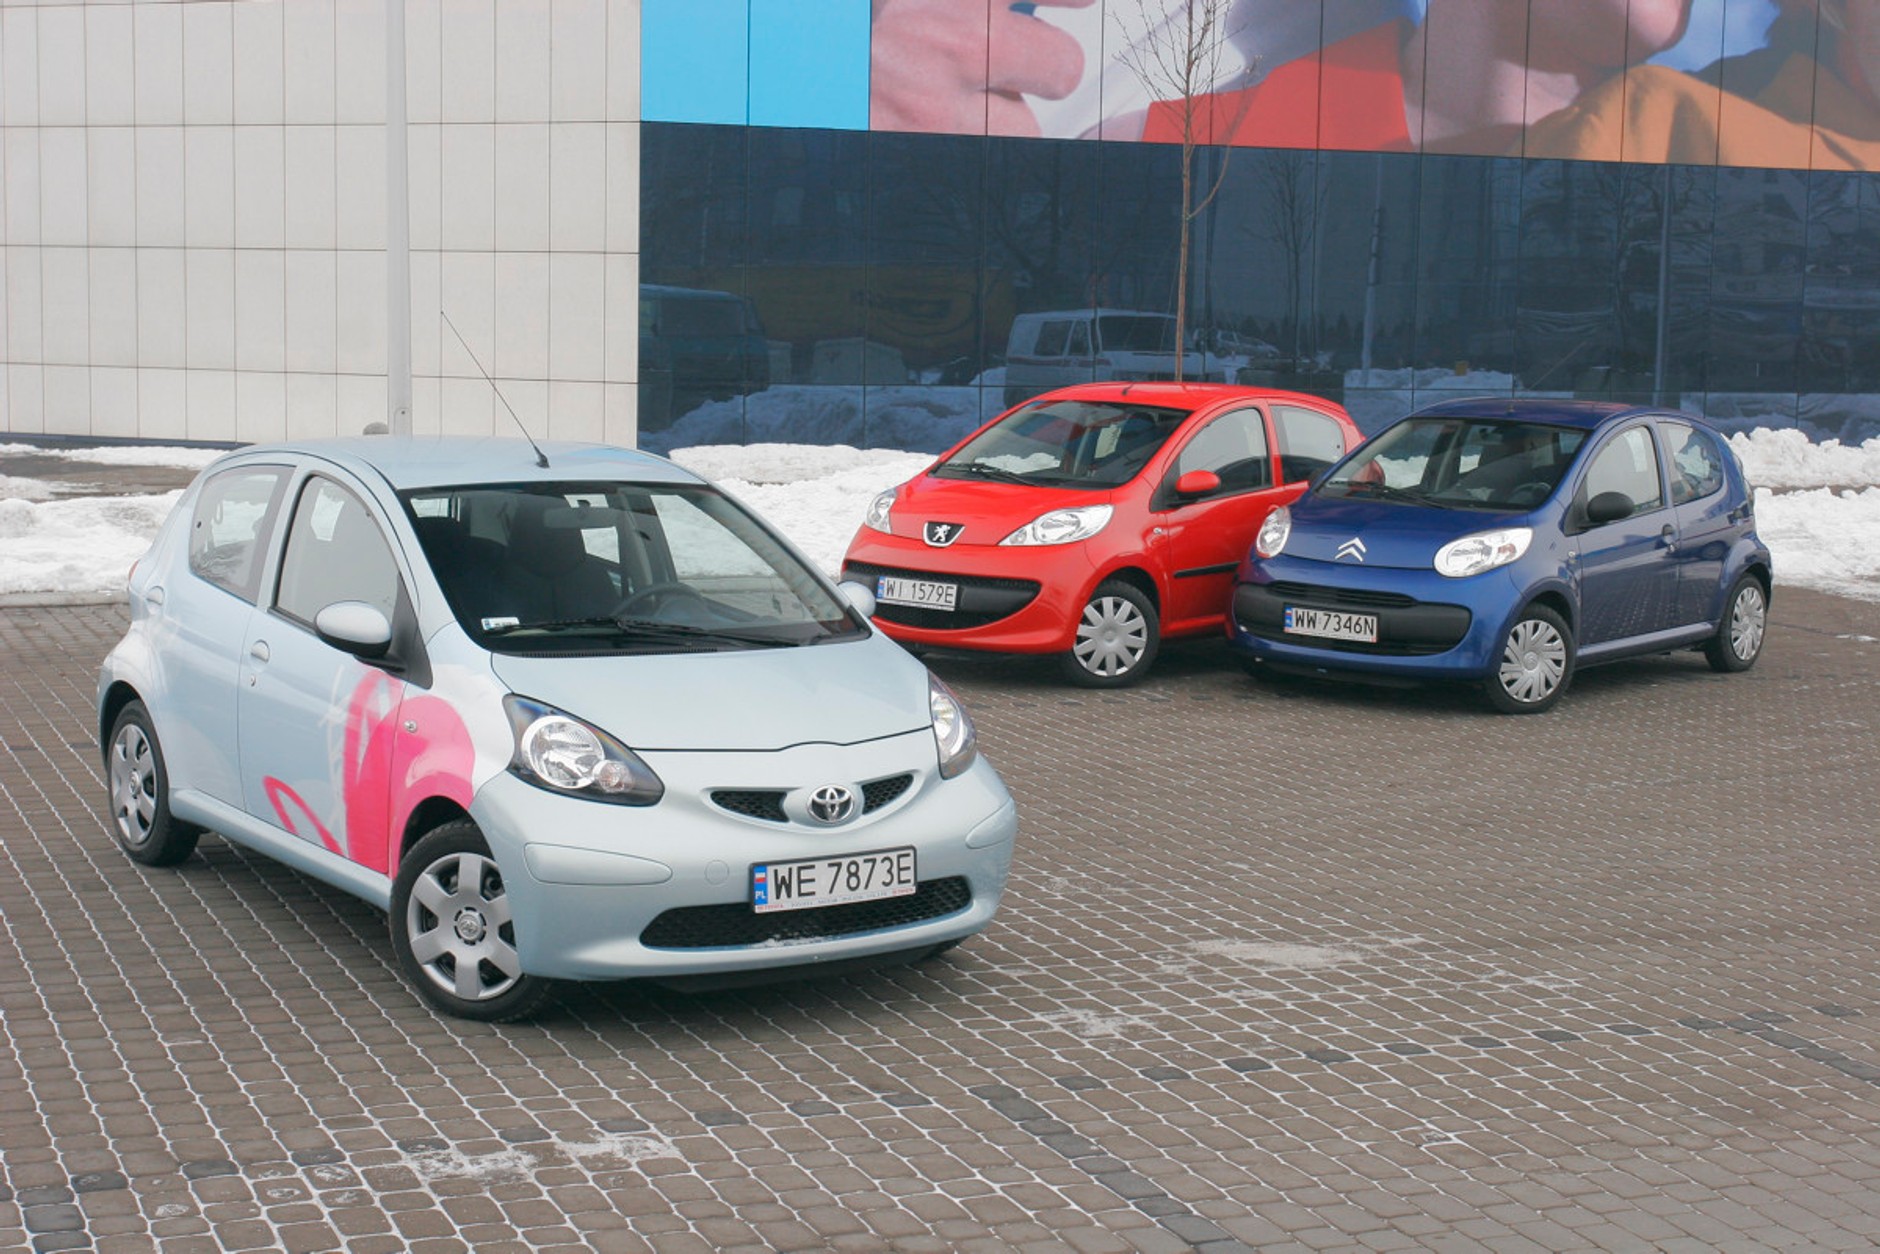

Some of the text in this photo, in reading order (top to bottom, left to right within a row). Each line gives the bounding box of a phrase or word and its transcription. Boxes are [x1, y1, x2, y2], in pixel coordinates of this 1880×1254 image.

[886, 579, 903, 598] WI
[911, 582, 955, 604] 1579E
[1295, 609, 1375, 636] WW 7346N
[773, 864, 816, 900] WE
[827, 852, 912, 894] 7873E
[755, 890, 766, 900] PL
